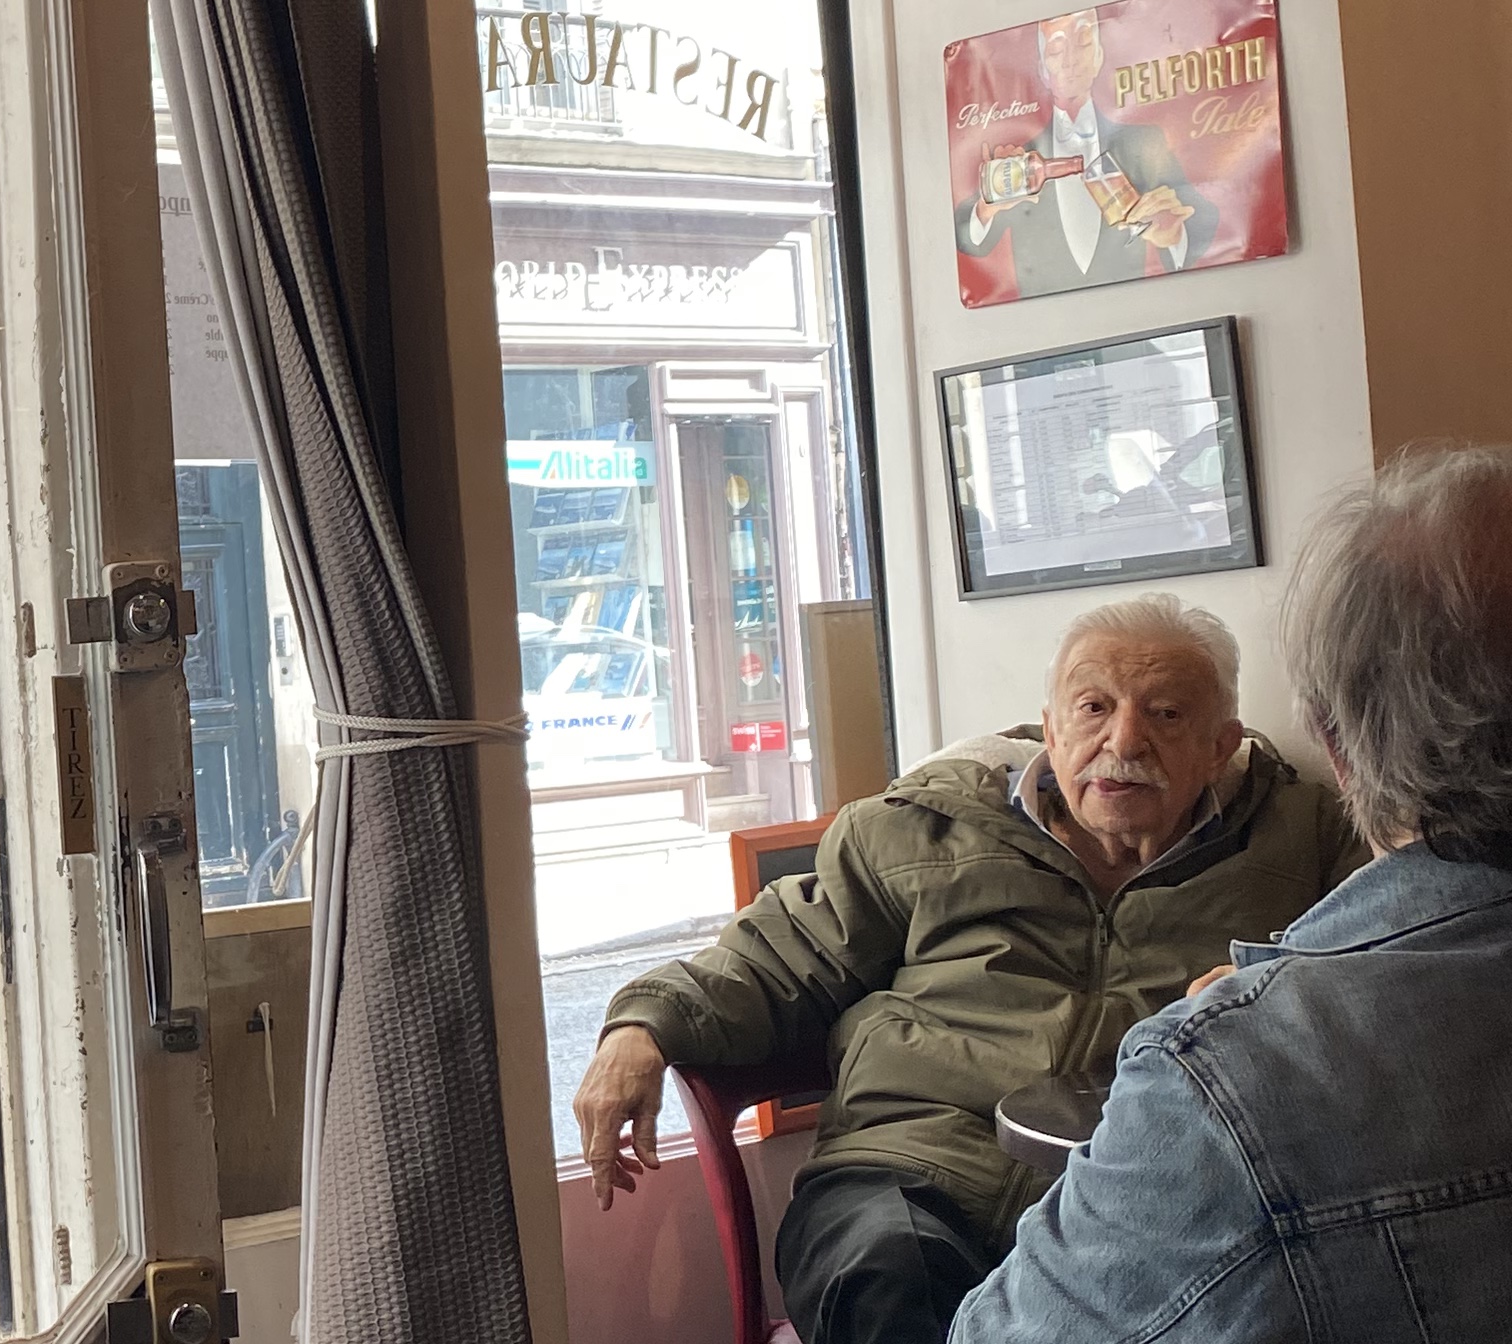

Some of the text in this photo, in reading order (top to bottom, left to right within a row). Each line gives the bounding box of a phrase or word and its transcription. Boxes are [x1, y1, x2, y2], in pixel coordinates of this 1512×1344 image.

[1114, 36, 1267, 109] PELFORTH
[956, 100, 1040, 130] Perfection
[1190, 91, 1265, 139] Pale
[541, 448, 648, 480] Alitalia
[541, 715, 618, 731] FRANCE
[62, 708, 87, 819] TIREZ
